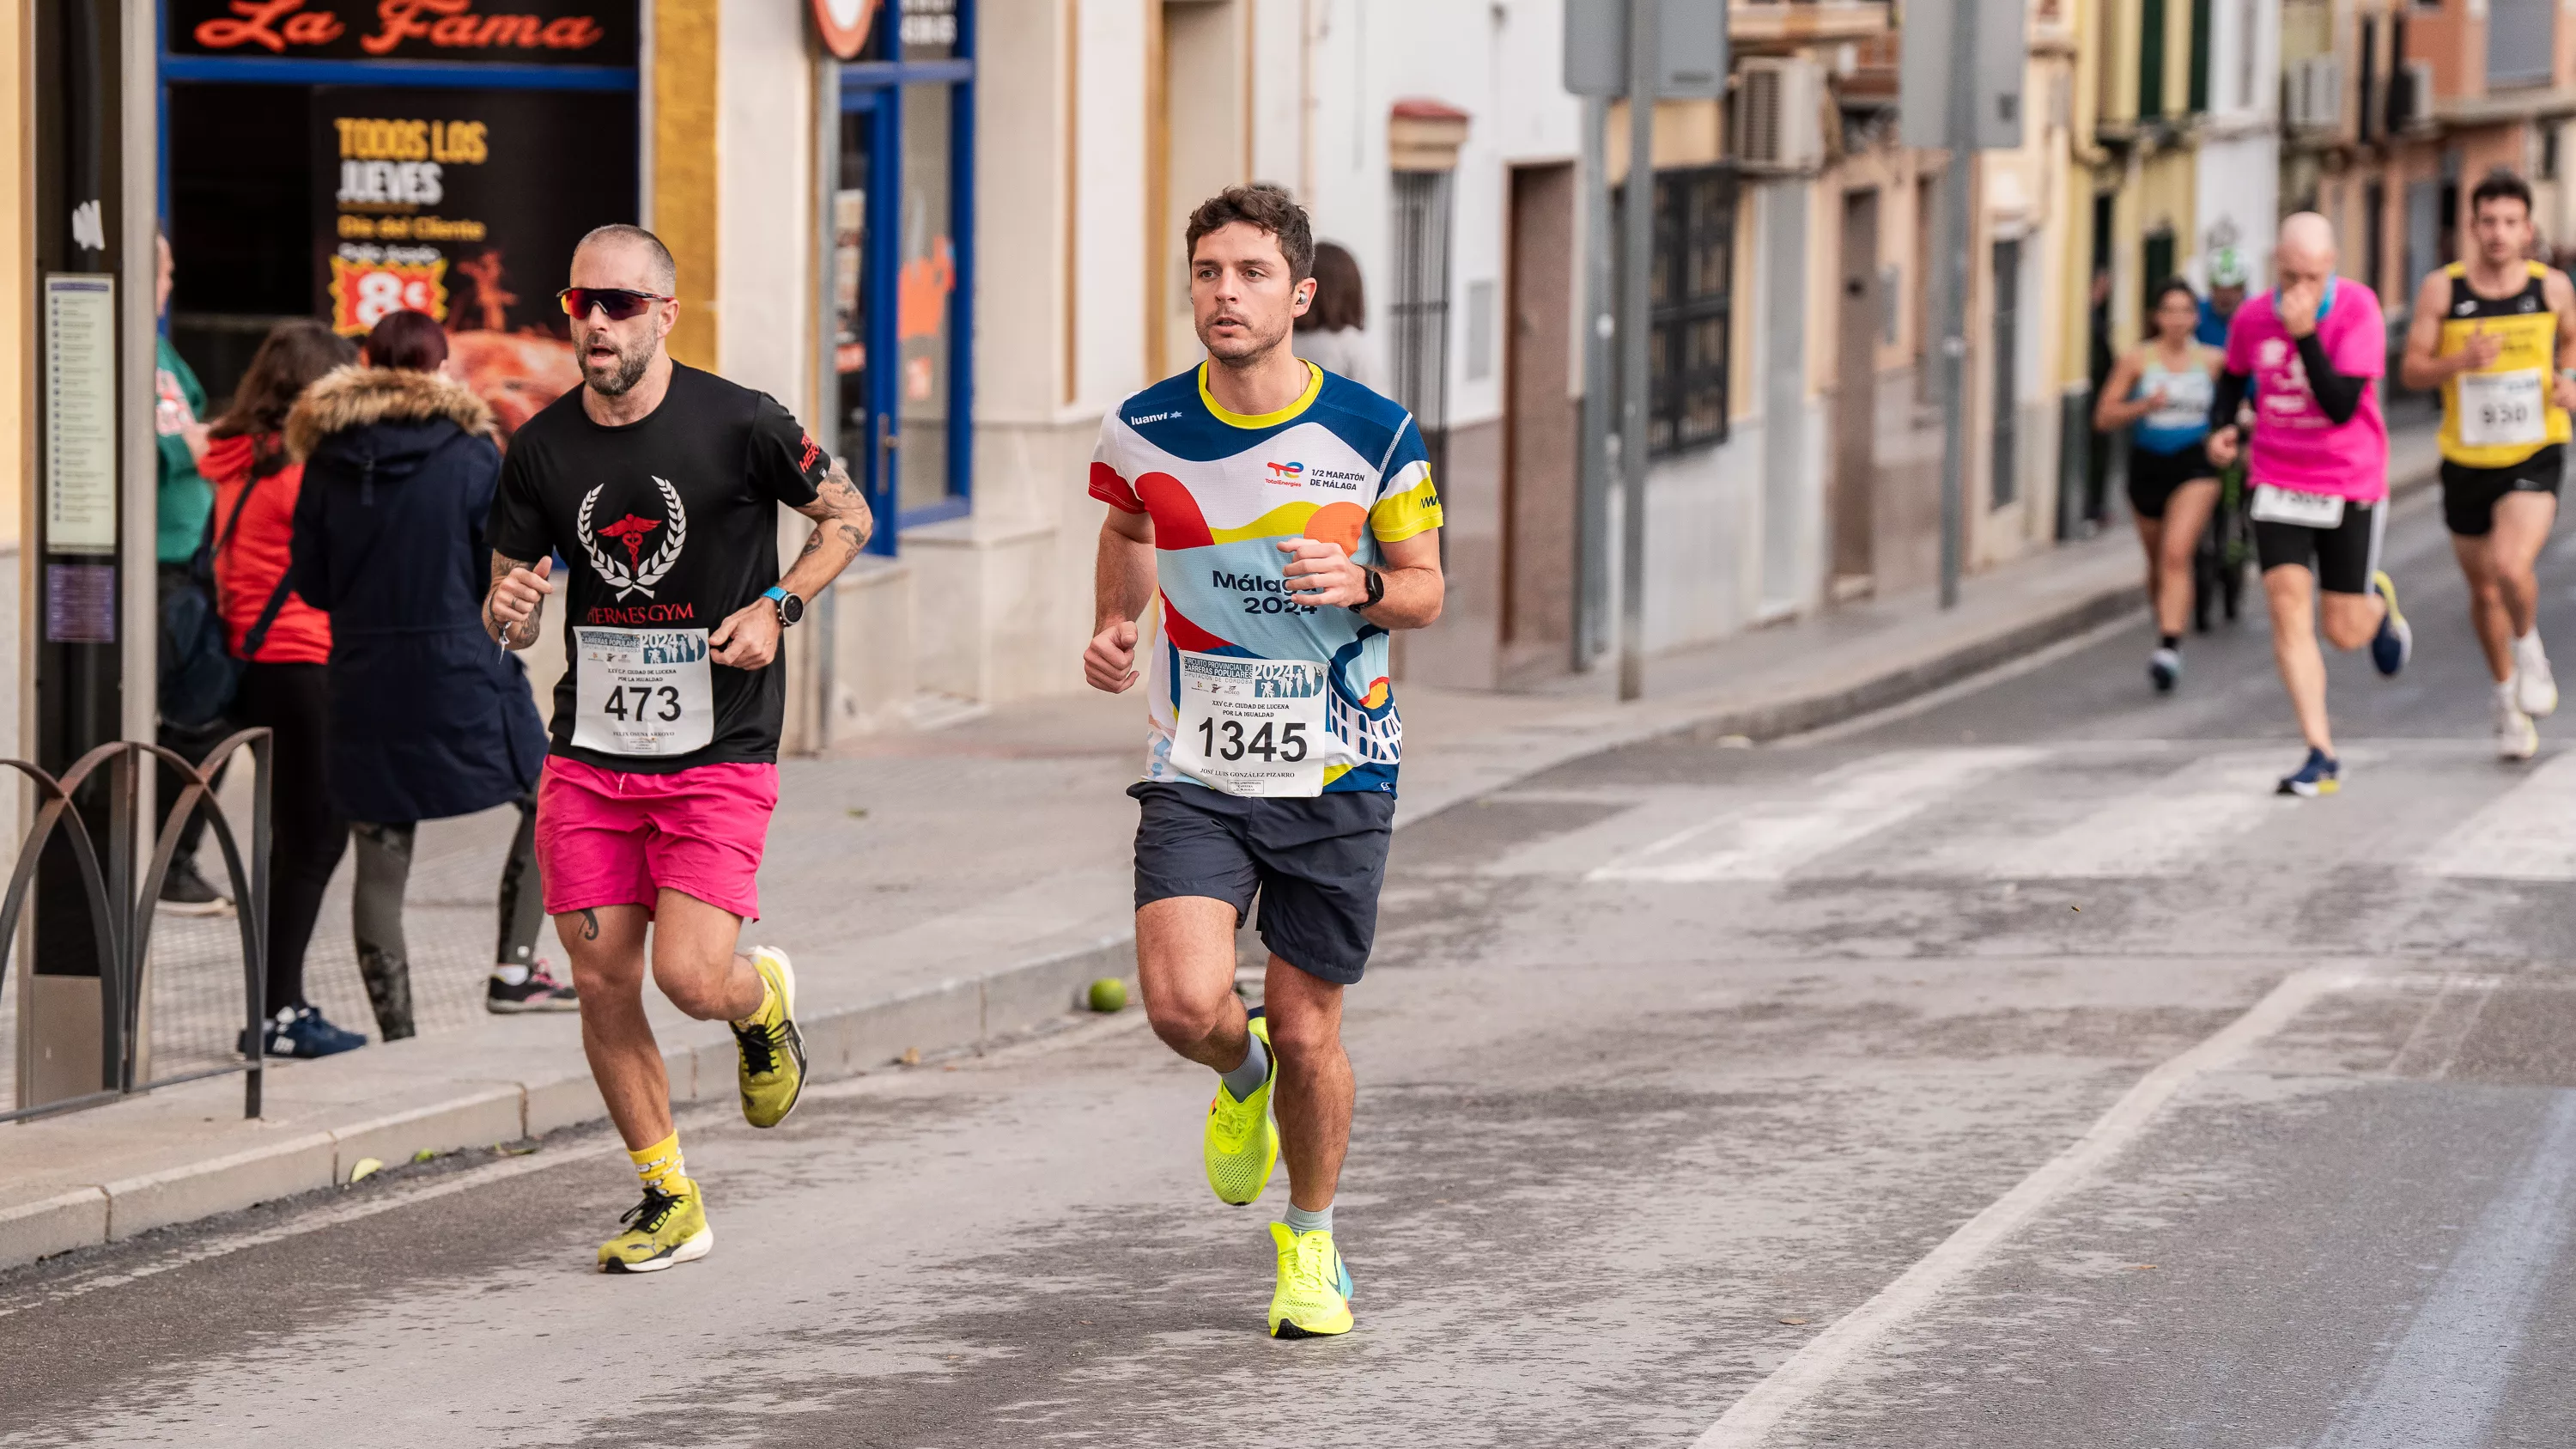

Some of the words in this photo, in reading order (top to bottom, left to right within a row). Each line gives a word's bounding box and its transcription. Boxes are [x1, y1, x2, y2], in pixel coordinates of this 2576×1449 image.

[193, 0, 344, 53] La
[360, 0, 603, 55] Fama
[334, 118, 429, 161] TODOS
[431, 119, 488, 164] LOS
[336, 161, 443, 205] JUEVES
[1131, 412, 1168, 425] luanvi
[1265, 478, 1302, 488] TotalEnergies
[1311, 469, 1324, 478] 1/2
[1326, 470, 1365, 482] MARATÓN
[1309, 478, 1321, 487] DE
[1322, 478, 1357, 490] MÁLAGA
[587, 606, 646, 624] HERMES
[648, 602, 695, 622] GYM
[641, 634, 677, 648] 2024
[1184, 658, 1207, 667] CIRCUITO
[1208, 661, 1243, 671] PROVINCIAL
[1184, 664, 1213, 675] CARRERAS
[1214, 669, 1253, 679] POPULARES
[1255, 664, 1295, 681] 2024
[605, 685, 681, 722] 473
[1199, 716, 1308, 763] 1345
